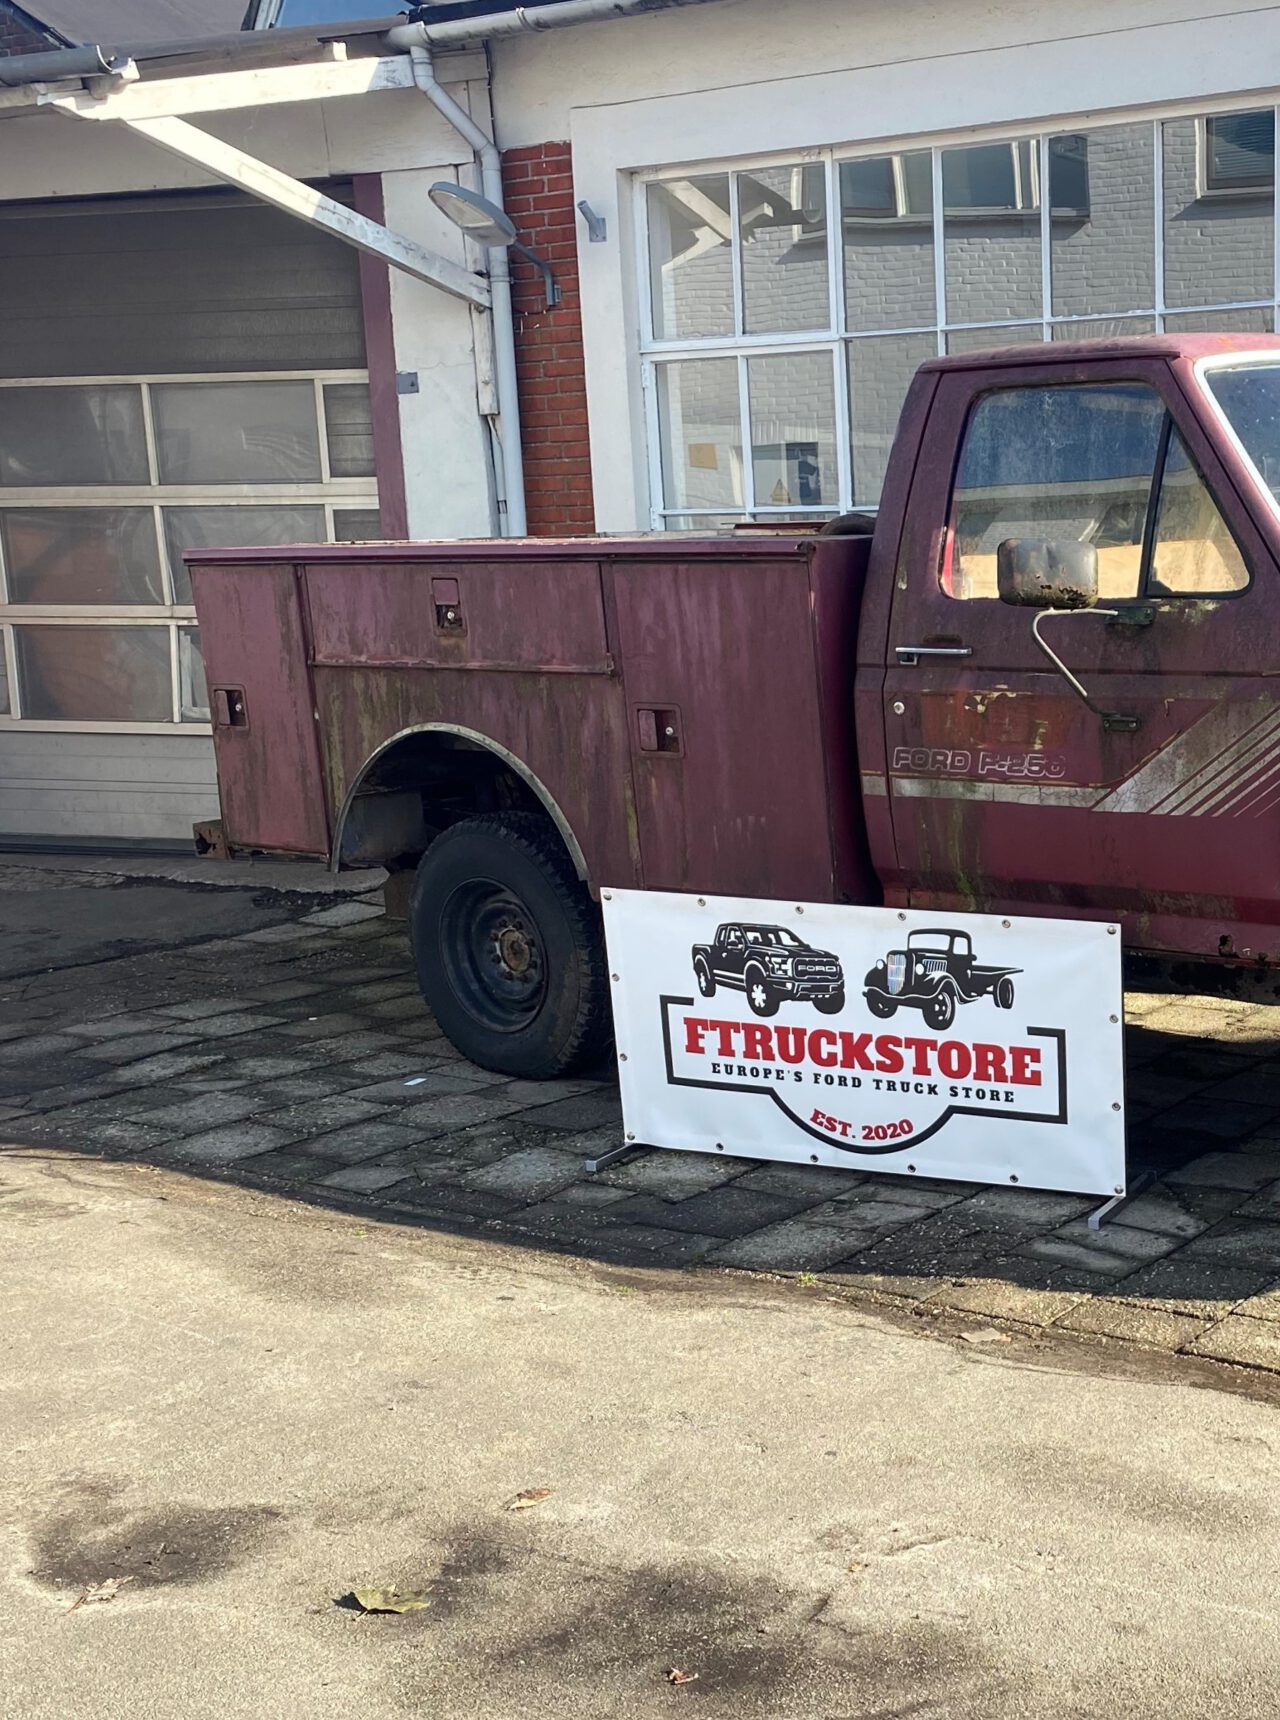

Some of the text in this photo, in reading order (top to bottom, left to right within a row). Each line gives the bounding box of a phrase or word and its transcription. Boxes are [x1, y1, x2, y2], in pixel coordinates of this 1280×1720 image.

[893, 747, 971, 773] FORD
[797, 964, 837, 972] FORD
[683, 1016, 1042, 1087] FTRUCKSTORE
[711, 1062, 1015, 1103] EUROPE'S FORD TRUCK STORE
[810, 1107, 914, 1141] EST. 2020
